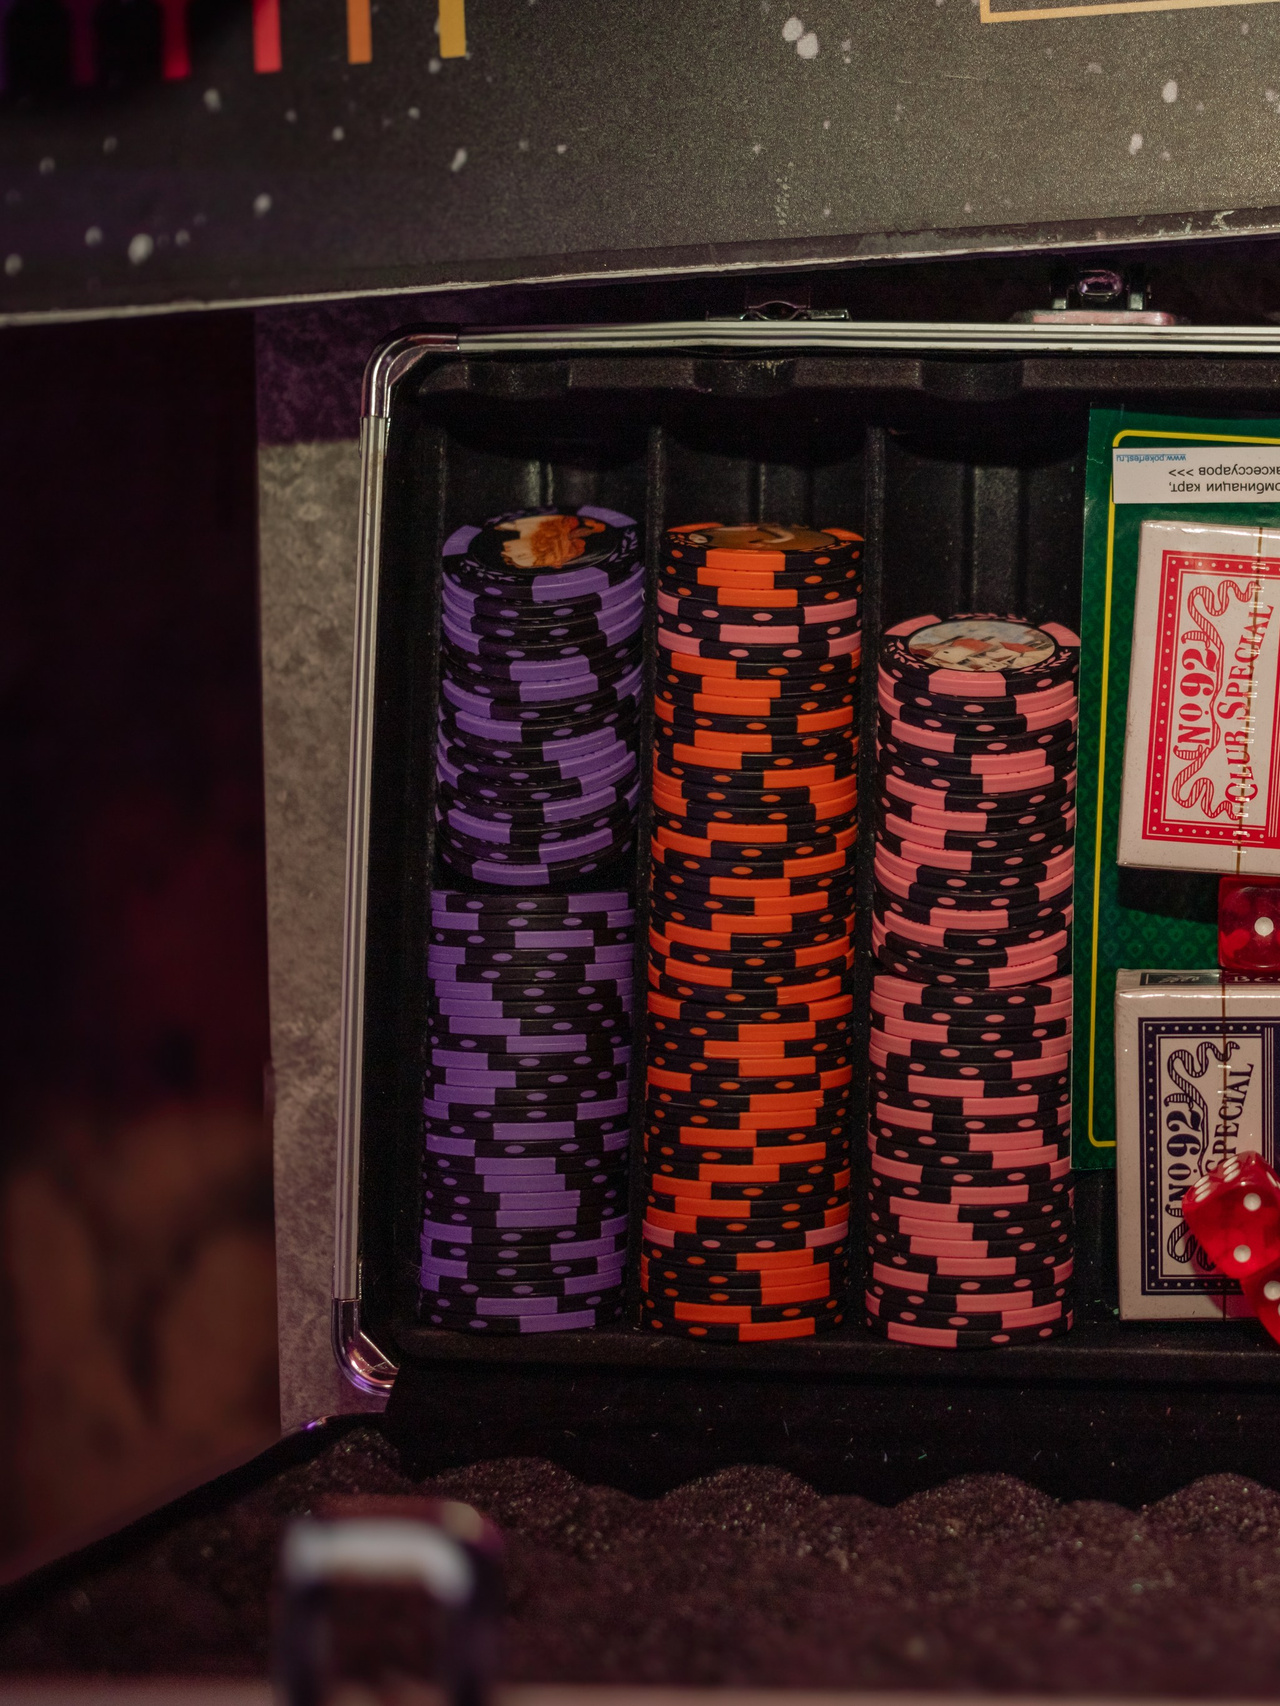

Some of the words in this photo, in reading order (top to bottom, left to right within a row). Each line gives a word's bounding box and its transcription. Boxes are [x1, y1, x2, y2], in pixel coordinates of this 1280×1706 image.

[1116, 453, 1187, 463] www.pokerfest.ru
[1168, 481, 1201, 492] карт,
[1179, 648, 1218, 698] 92
[1216, 604, 1274, 720] SPECIAL
[1224, 730, 1259, 803] CLUB
[1166, 1110, 1201, 1157] 92
